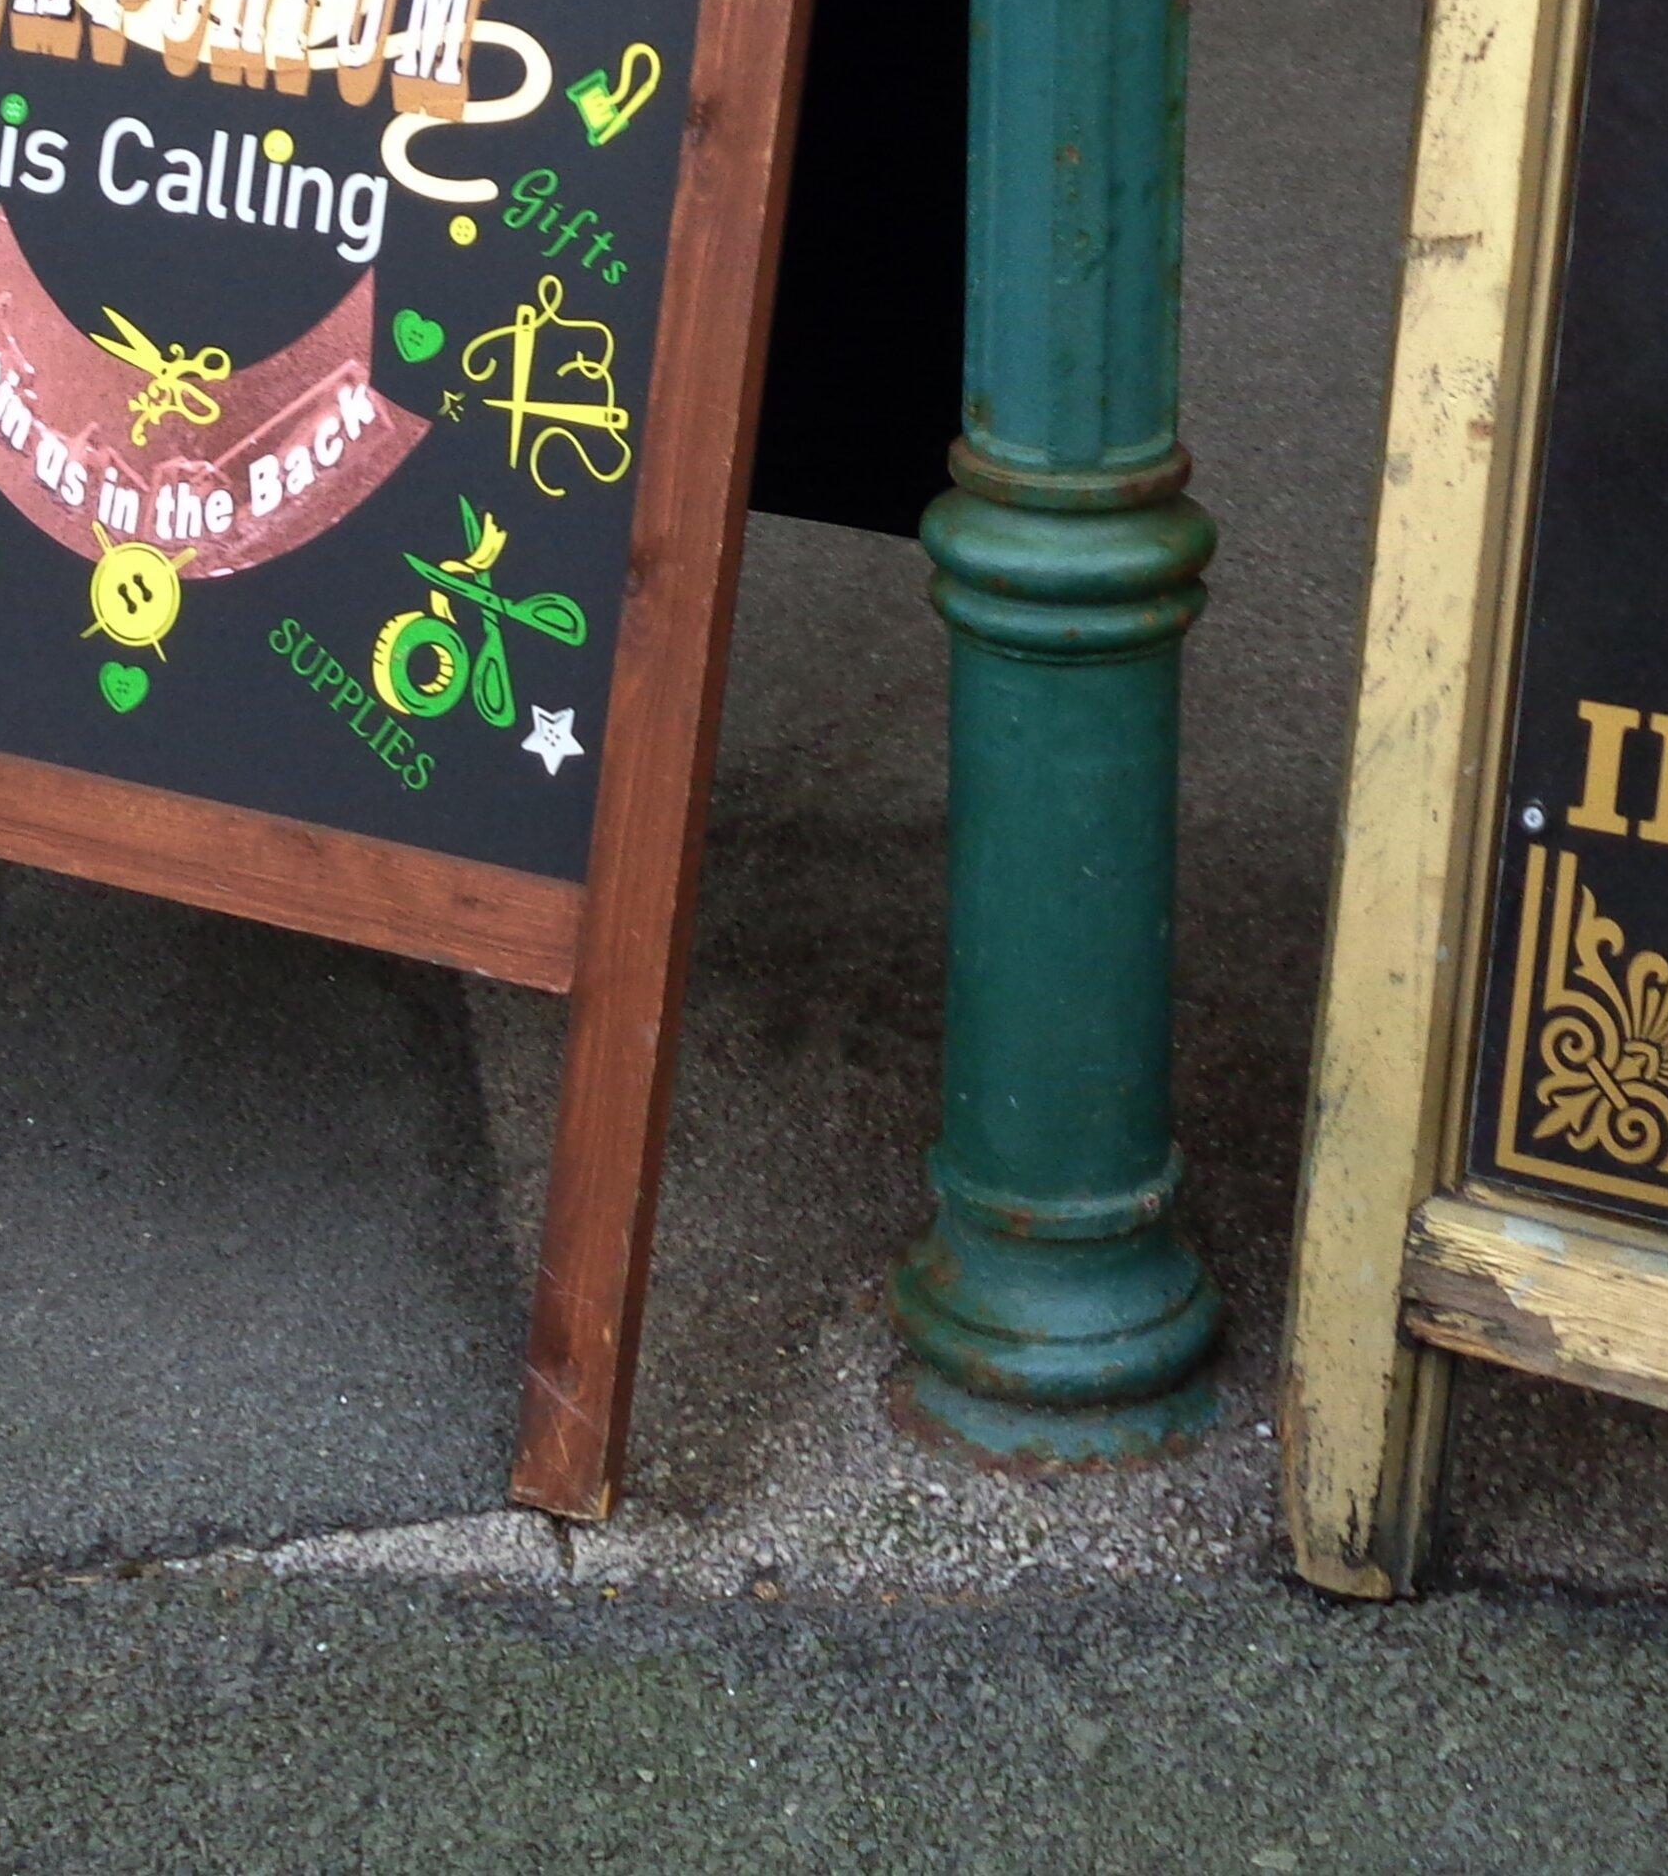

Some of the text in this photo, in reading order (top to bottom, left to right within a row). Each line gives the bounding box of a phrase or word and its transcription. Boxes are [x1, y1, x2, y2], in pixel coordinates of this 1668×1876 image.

[97, 116, 389, 264] Calling
[500, 166, 632, 289] Gifts
[35, 428, 87, 506] us
[98, 467, 139, 534] in
[155, 481, 234, 540] the
[248, 381, 377, 518] Back
[265, 616, 438, 794] SUPPLIES
